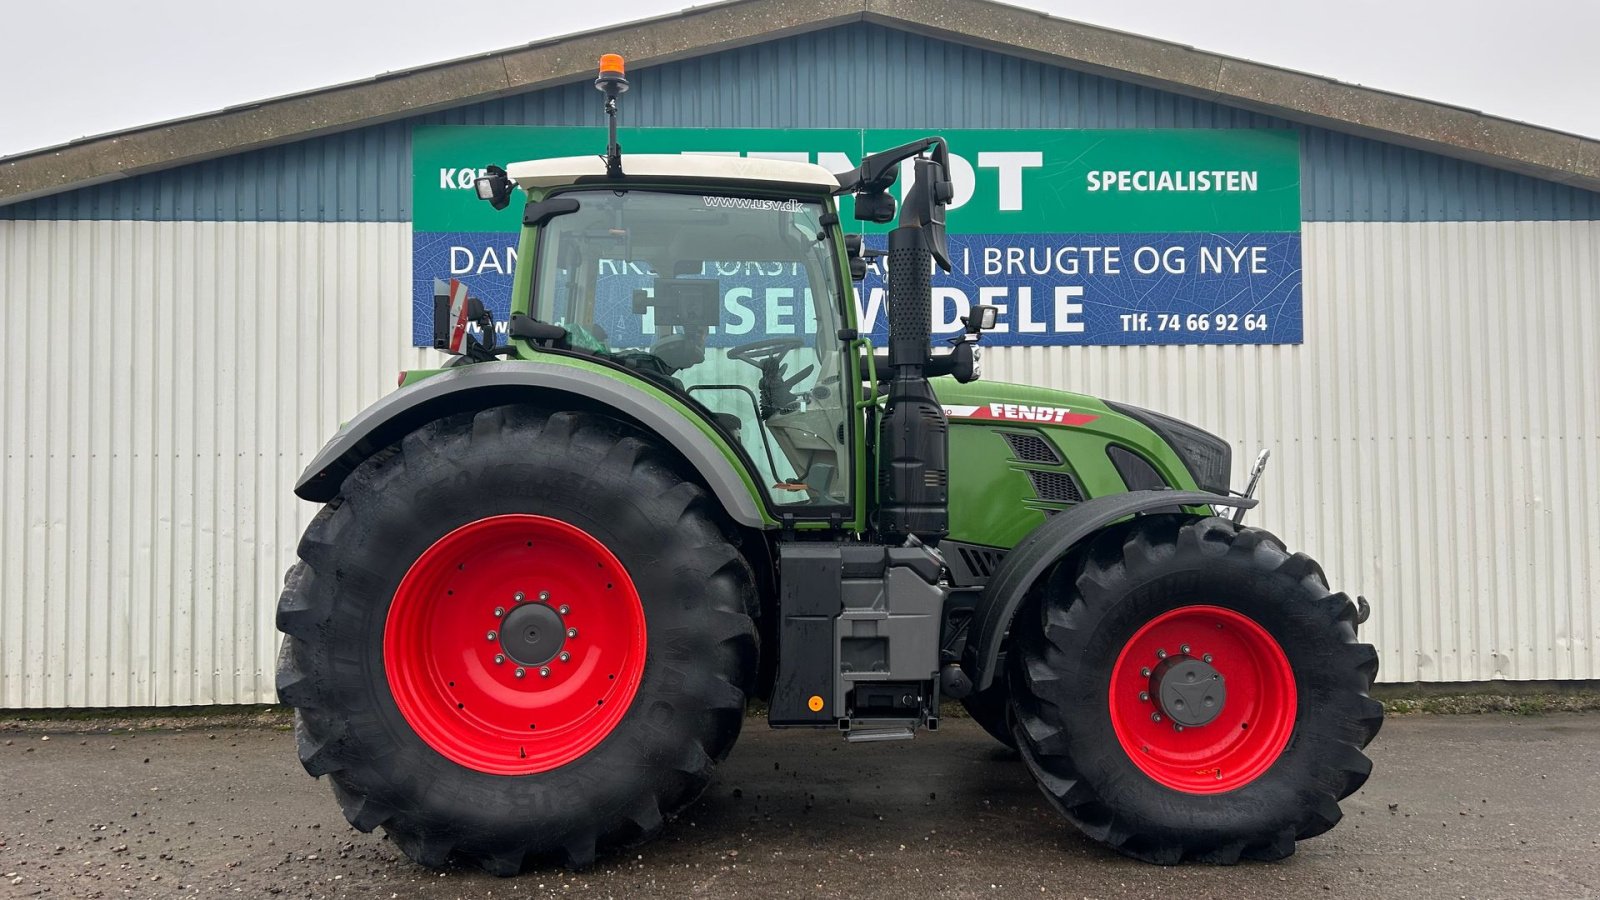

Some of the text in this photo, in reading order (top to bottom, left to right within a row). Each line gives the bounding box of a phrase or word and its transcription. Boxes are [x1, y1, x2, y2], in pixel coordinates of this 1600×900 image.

[1086, 170, 1258, 192] SPECIALISTEN
[703, 195, 804, 213] www.usv.dk
[964, 247, 970, 275] I
[984, 246, 1121, 275] BRUGTE
[1133, 246, 1186, 275] OG
[1200, 246, 1268, 274] NYE
[1120, 313, 1268, 332] Tlf. 74 66 92 64
[990, 402, 1070, 423] FENDT
